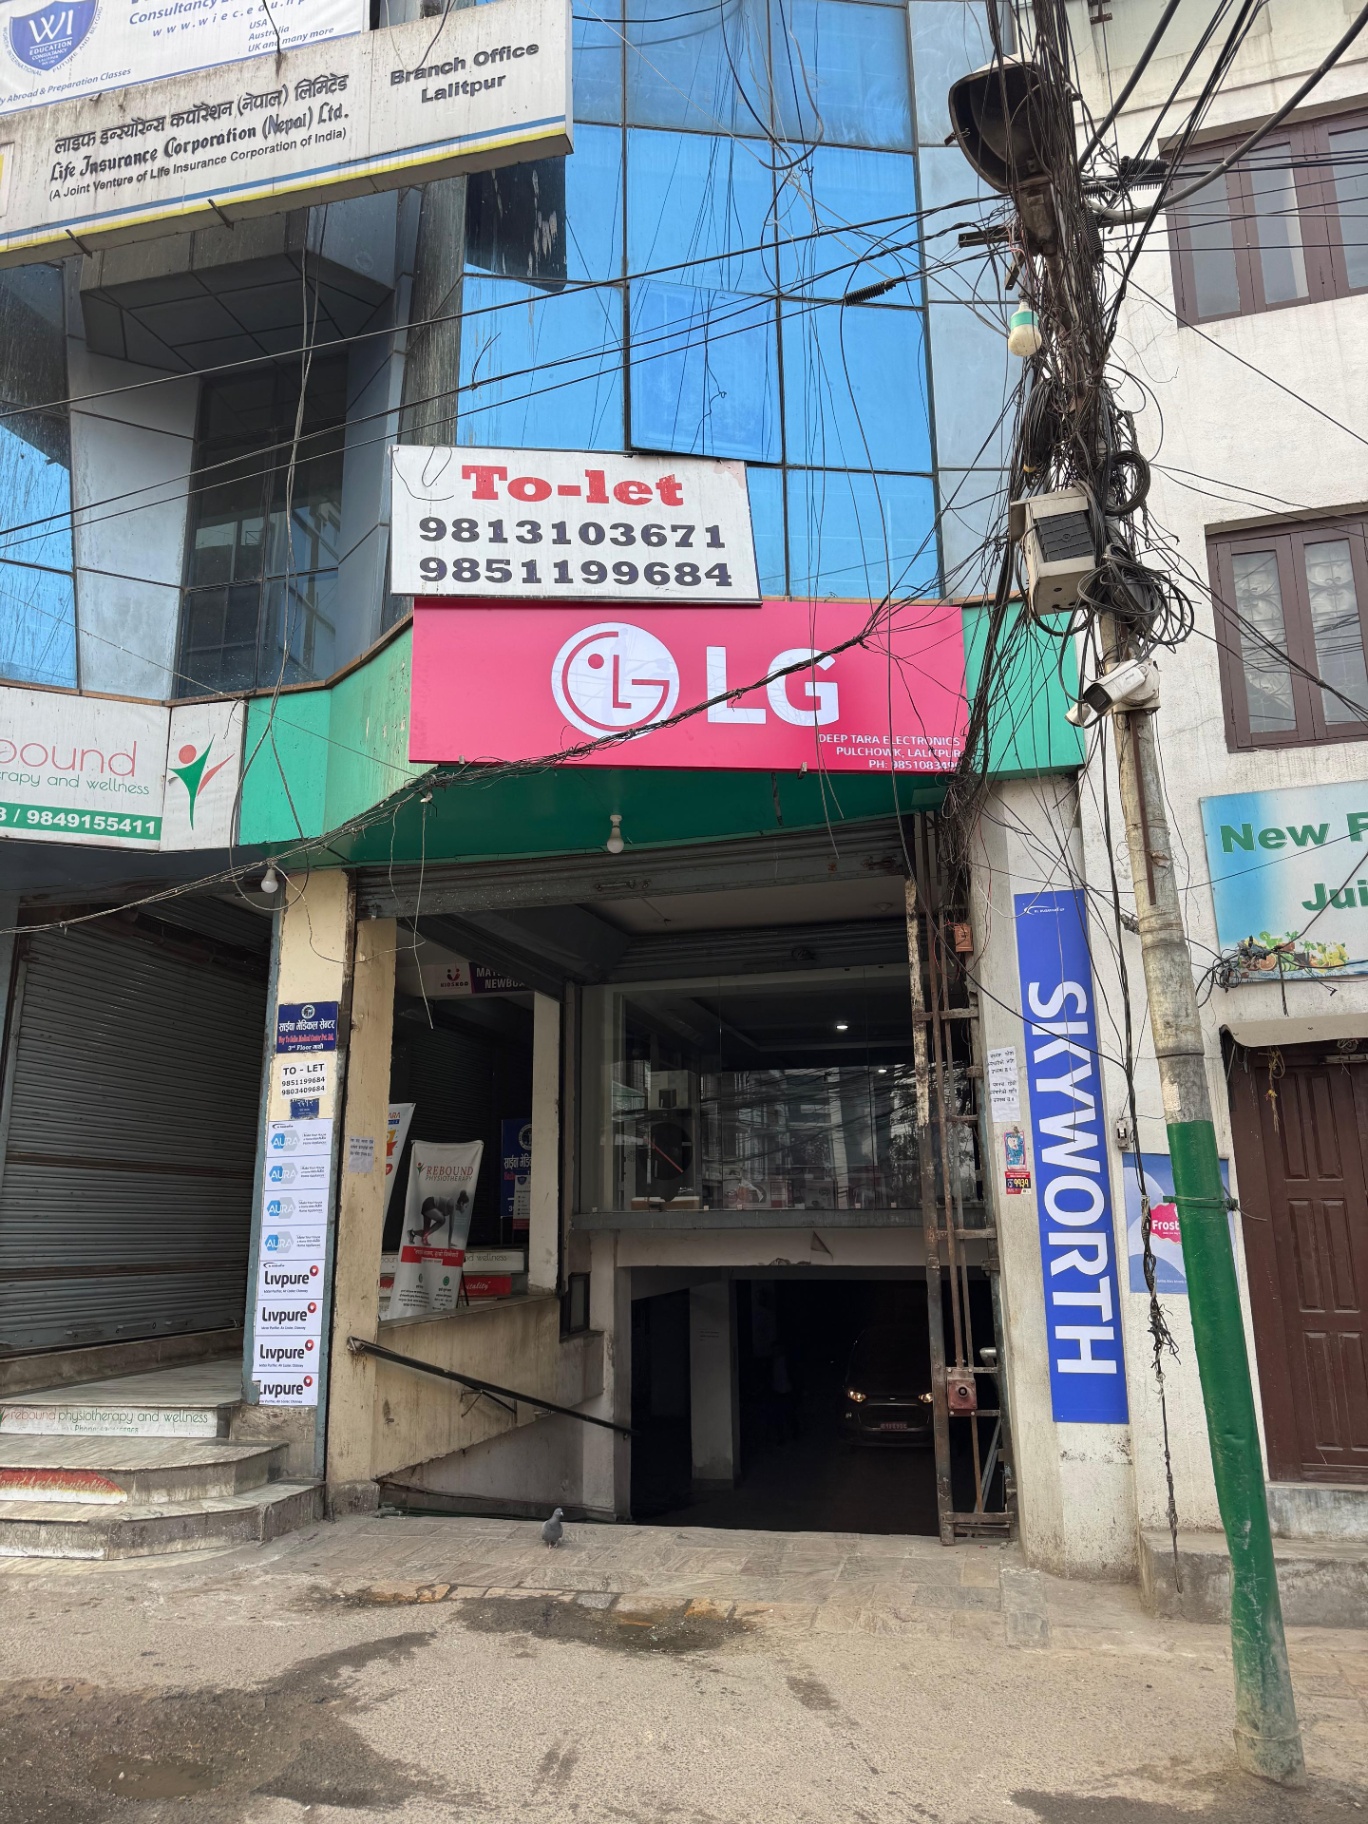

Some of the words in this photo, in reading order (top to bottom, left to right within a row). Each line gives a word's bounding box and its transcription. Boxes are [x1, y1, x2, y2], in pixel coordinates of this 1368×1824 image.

[28, 10, 74, 43] WI
[249, 19, 267, 30] USA
[248, 26, 290, 42] Australia
[248, 43, 261, 52] UK
[282, 33, 308, 46] many
[310, 27, 334, 38] more
[30, 40, 72, 56] EDUCATION
[390, 57, 466, 86] Branch
[473, 44, 539, 66] Office
[6, 89, 38, 104] Abroad
[40, 87, 46, 96] &
[48, 76, 98, 94] Preparation
[100, 68, 132, 81] Classes
[422, 75, 506, 104] Lalitpur
[54, 132, 96, 154] लाइफ
[237, 84, 289, 116] (नेपाल)
[295, 73, 350, 102] लिमिटेड
[50, 161, 76, 182] Life
[80, 149, 158, 176] Insurance
[164, 126, 256, 158] Corporation
[262, 106, 314, 141] (Nepal)
[318, 102, 350, 124] Ltd.
[49, 189, 60, 202] (A
[64, 184, 90, 198] Joint
[93, 176, 134, 192] Venture
[136, 172, 148, 182] of
[150, 166, 170, 180] Life
[173, 156, 227, 174] Insurance
[230, 140, 297, 161] Corporation
[300, 135, 312, 147] of
[314, 127, 346, 144] India)
[461, 464, 684, 507] To-let
[419, 517, 726, 549] 9813103671
[419, 556, 733, 587] 9851199684
[706, 645, 839, 727] LG
[818, 734, 848, 743] DEEP
[851, 734, 880, 744] TARA
[883, 736, 960, 746] ELECTRONICS
[836, 746, 905, 758] PULCHOWK,
[869, 760, 888, 769] PH:
[47, 774, 80, 788] and
[86, 778, 150, 795] wellness
[26, 810, 156, 835] 9849155411
[1220, 823, 1330, 853] New
[283, 1066, 296, 1076] TO
[307, 1064, 324, 1073] LET
[272, 1138, 298, 1146] AURA
[270, 1171, 296, 1179] AURA
[426, 1166, 474, 1175] REBOUND
[1029, 981, 1117, 1374] SKYWORTH
[268, 1204, 294, 1212] AURA
[266, 1239, 292, 1247] AURA
[477, 1254, 507, 1262] wellness
[265, 1271, 309, 1288] Livpure
[262, 1307, 307, 1324] Livpure
[260, 1344, 304, 1362] Livpure
[10, 1409, 56, 1420] rebound
[58, 1409, 134, 1424] physiotherapy
[138, 1410, 159, 1422] and
[163, 1409, 208, 1423] wellness
